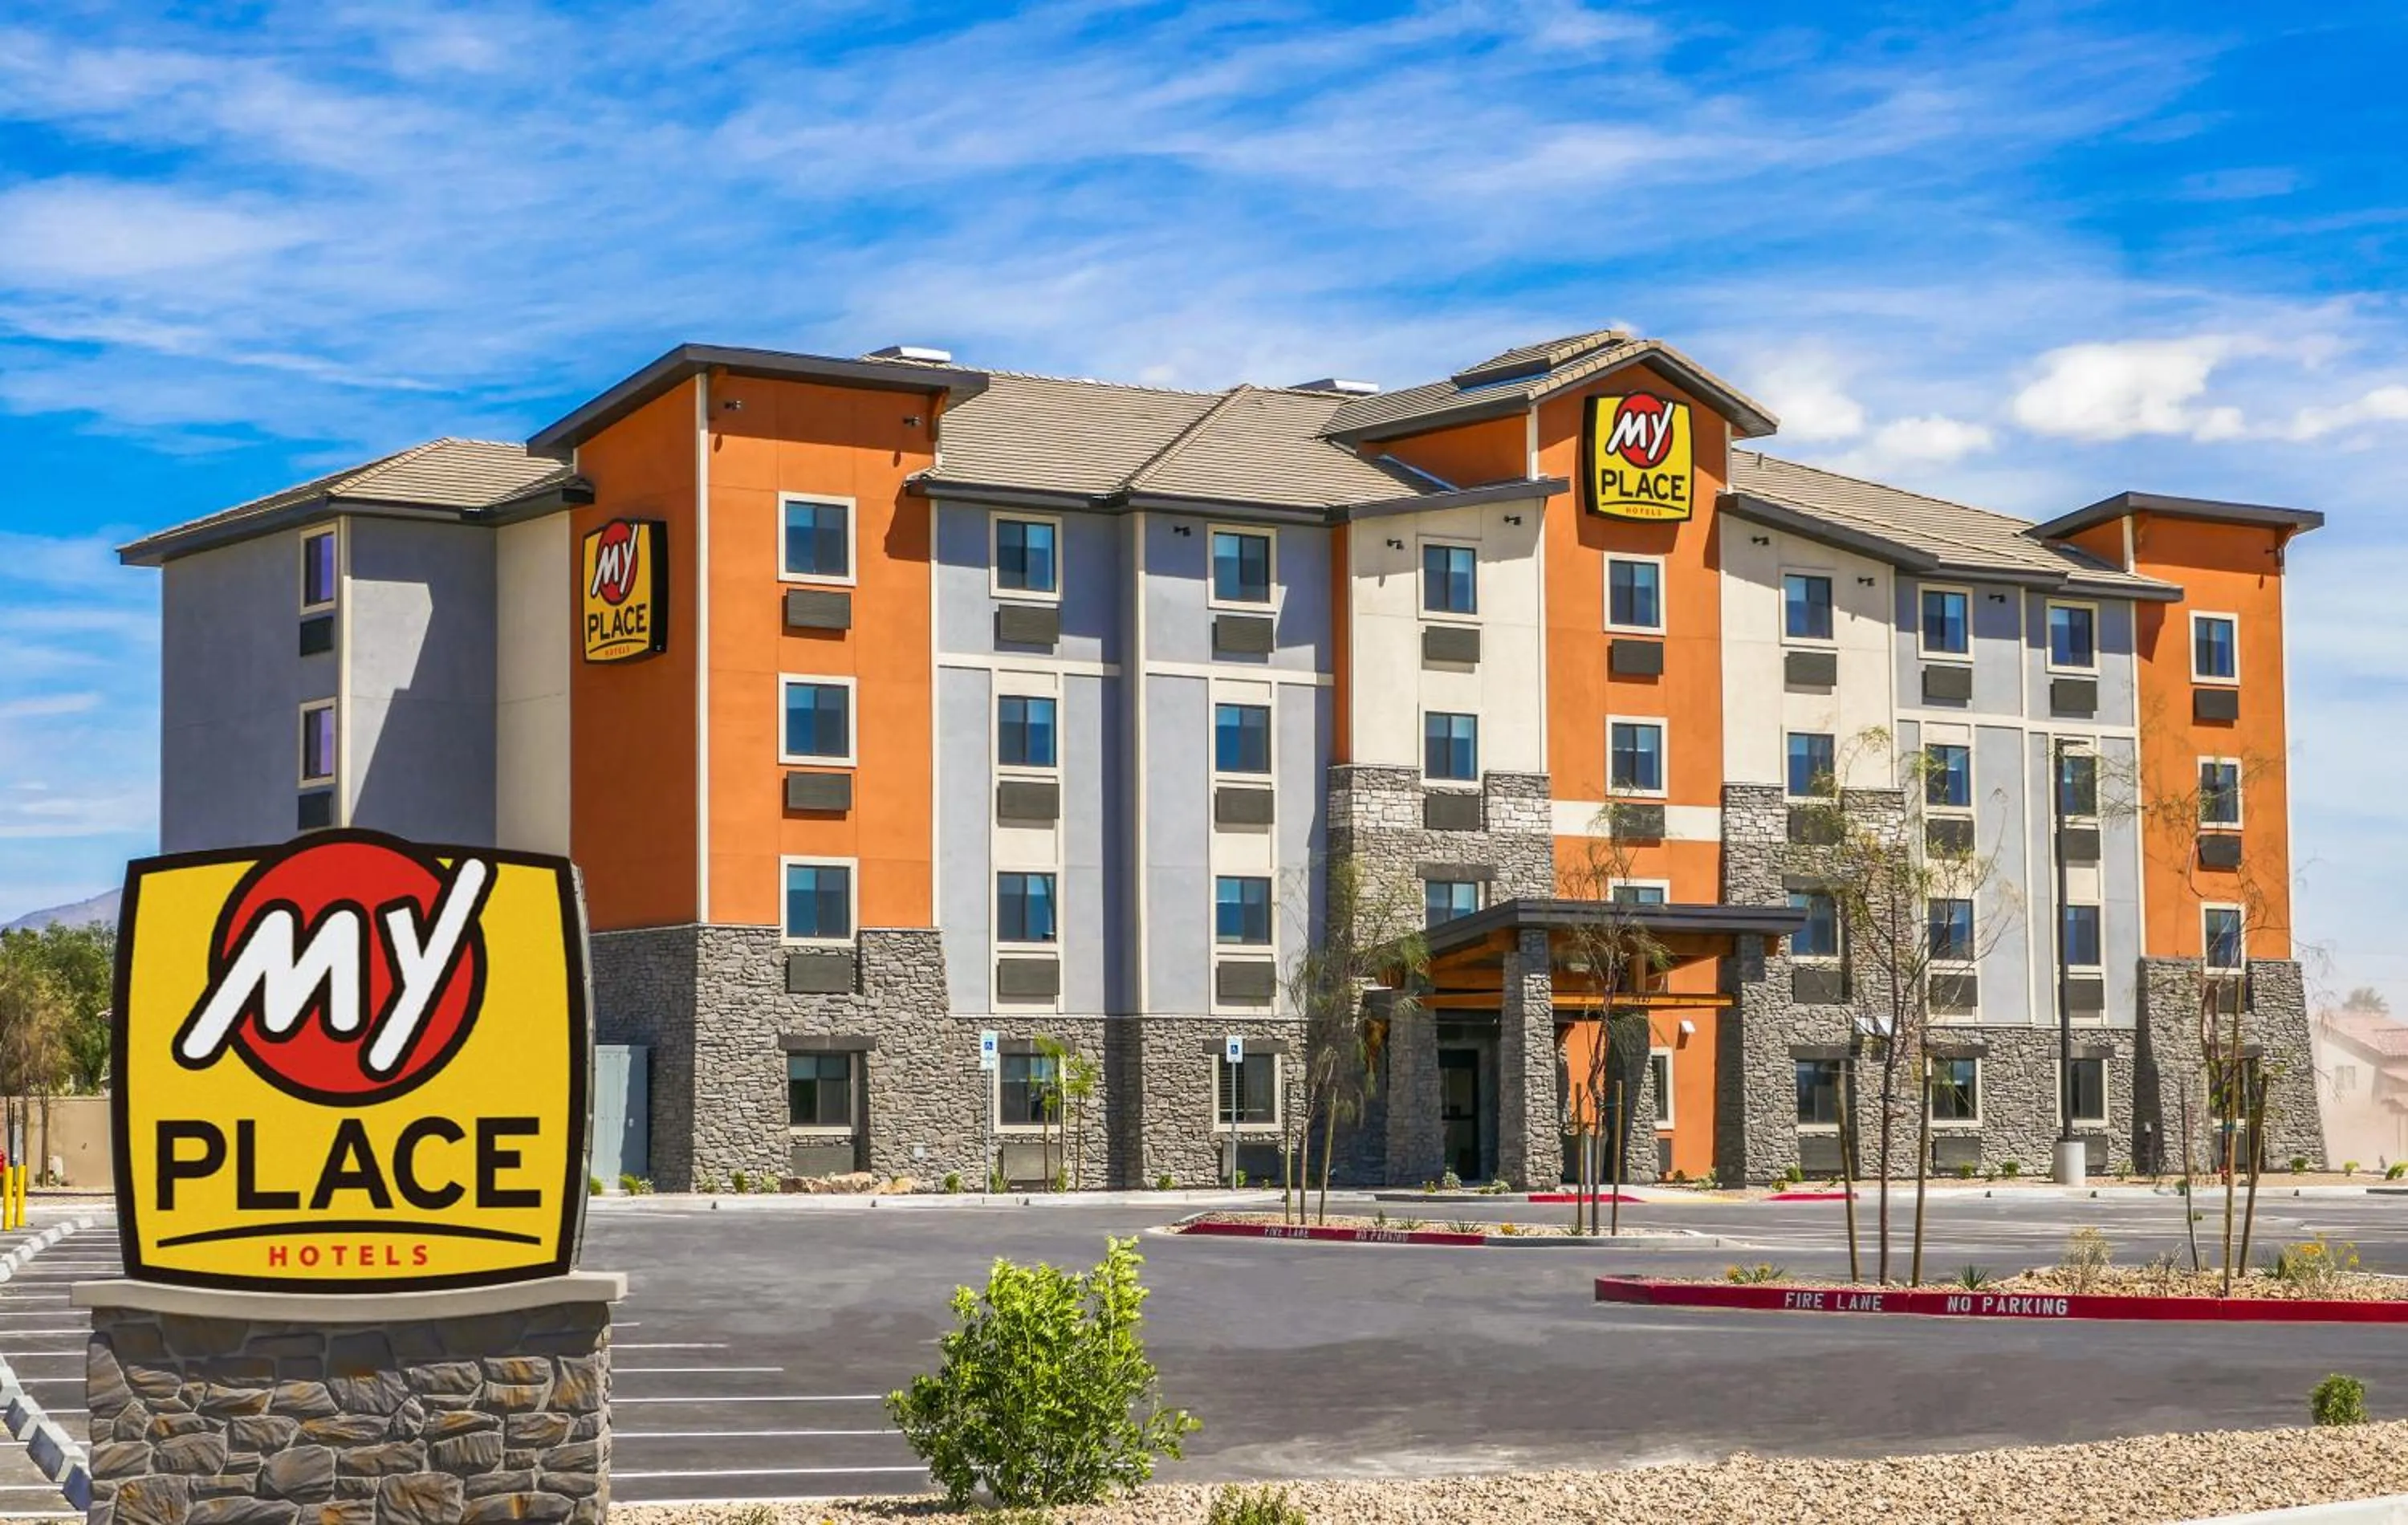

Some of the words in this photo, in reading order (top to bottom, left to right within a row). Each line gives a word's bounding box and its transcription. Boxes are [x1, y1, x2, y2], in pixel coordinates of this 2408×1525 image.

[1601, 469, 1686, 501] PLACE
[1626, 507, 1662, 515] HOTELS
[588, 604, 646, 642] PLACE
[156, 1116, 542, 1211] PLACE
[269, 1245, 428, 1267] HOTELS
[1784, 1291, 1824, 1308] FIRE
[1836, 1294, 1884, 1311] LANE
[1946, 1295, 1972, 1312] NO
[1982, 1296, 2068, 1316] PARKING
